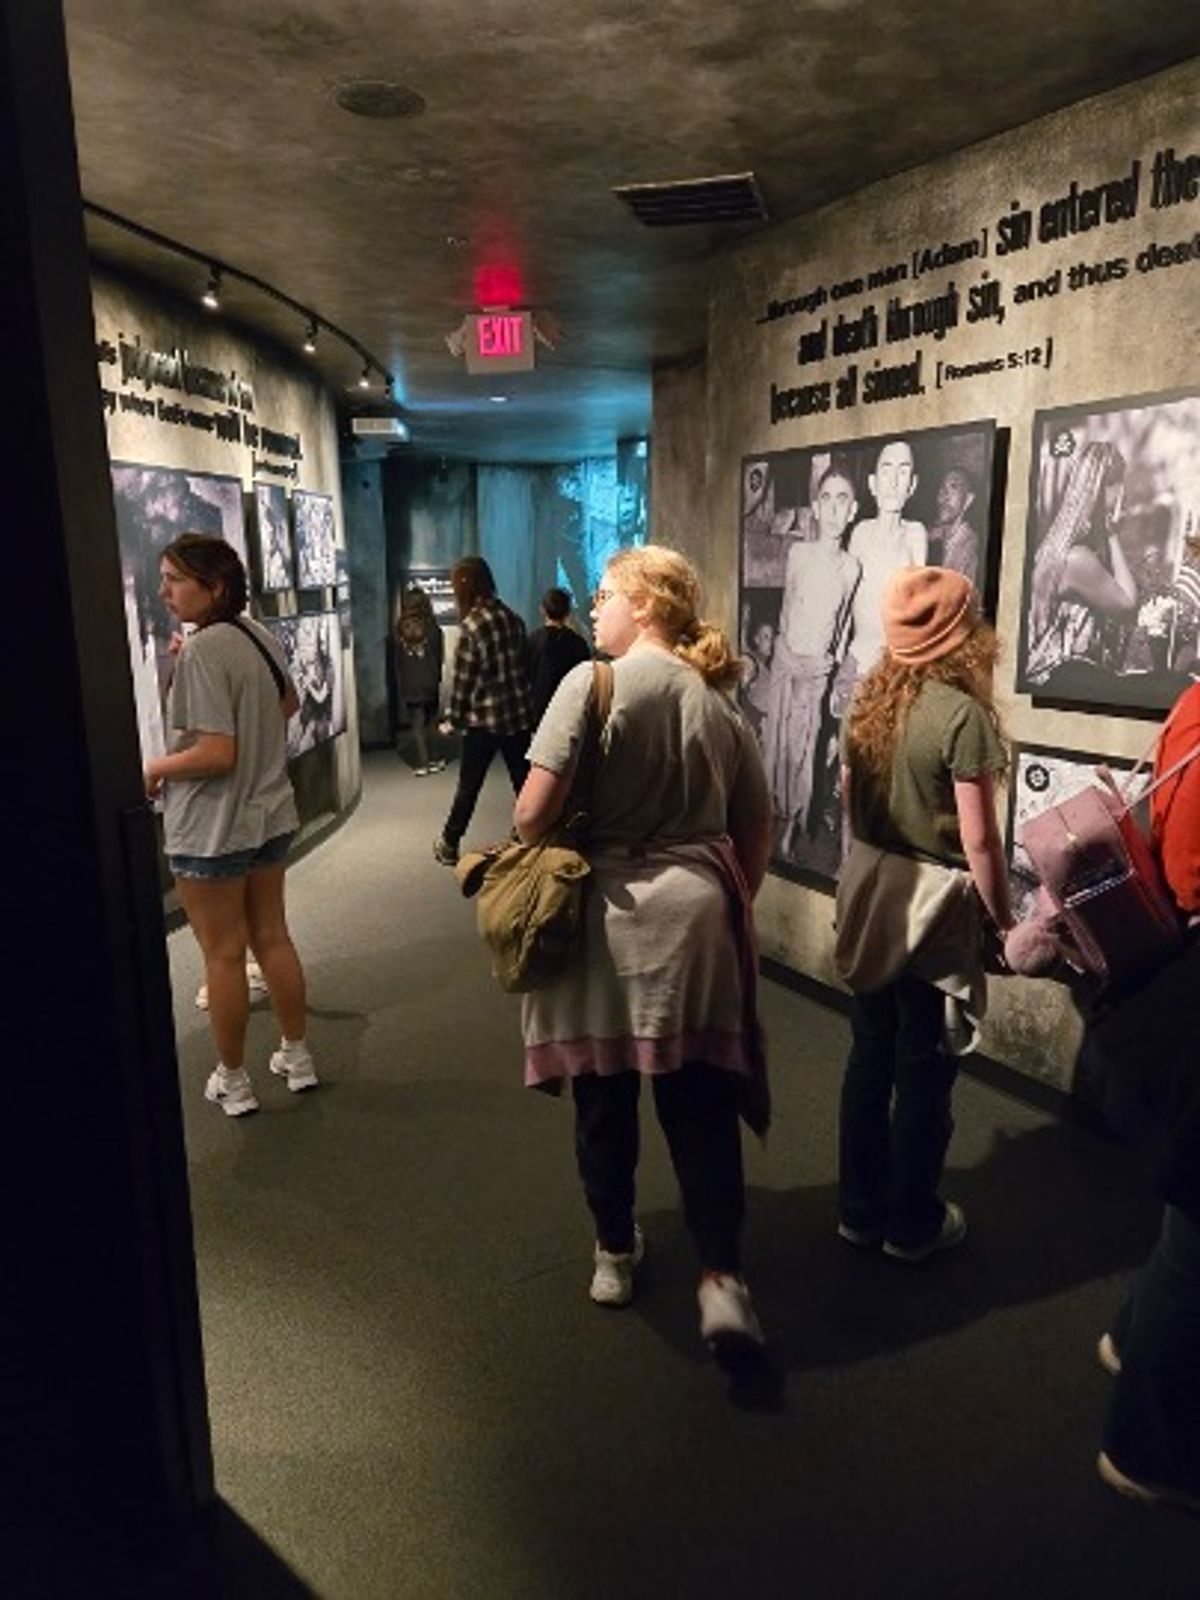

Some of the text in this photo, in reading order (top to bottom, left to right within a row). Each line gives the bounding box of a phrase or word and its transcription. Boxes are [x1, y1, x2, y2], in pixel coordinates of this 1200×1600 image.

[867, 264, 907, 291] man
[996, 201, 1032, 255] sin
[1038, 160, 1141, 243] entered
[478, 316, 523, 355] EXIT
[886, 281, 958, 343] through
[1013, 269, 1062, 304] and
[1067, 257, 1129, 291] thus
